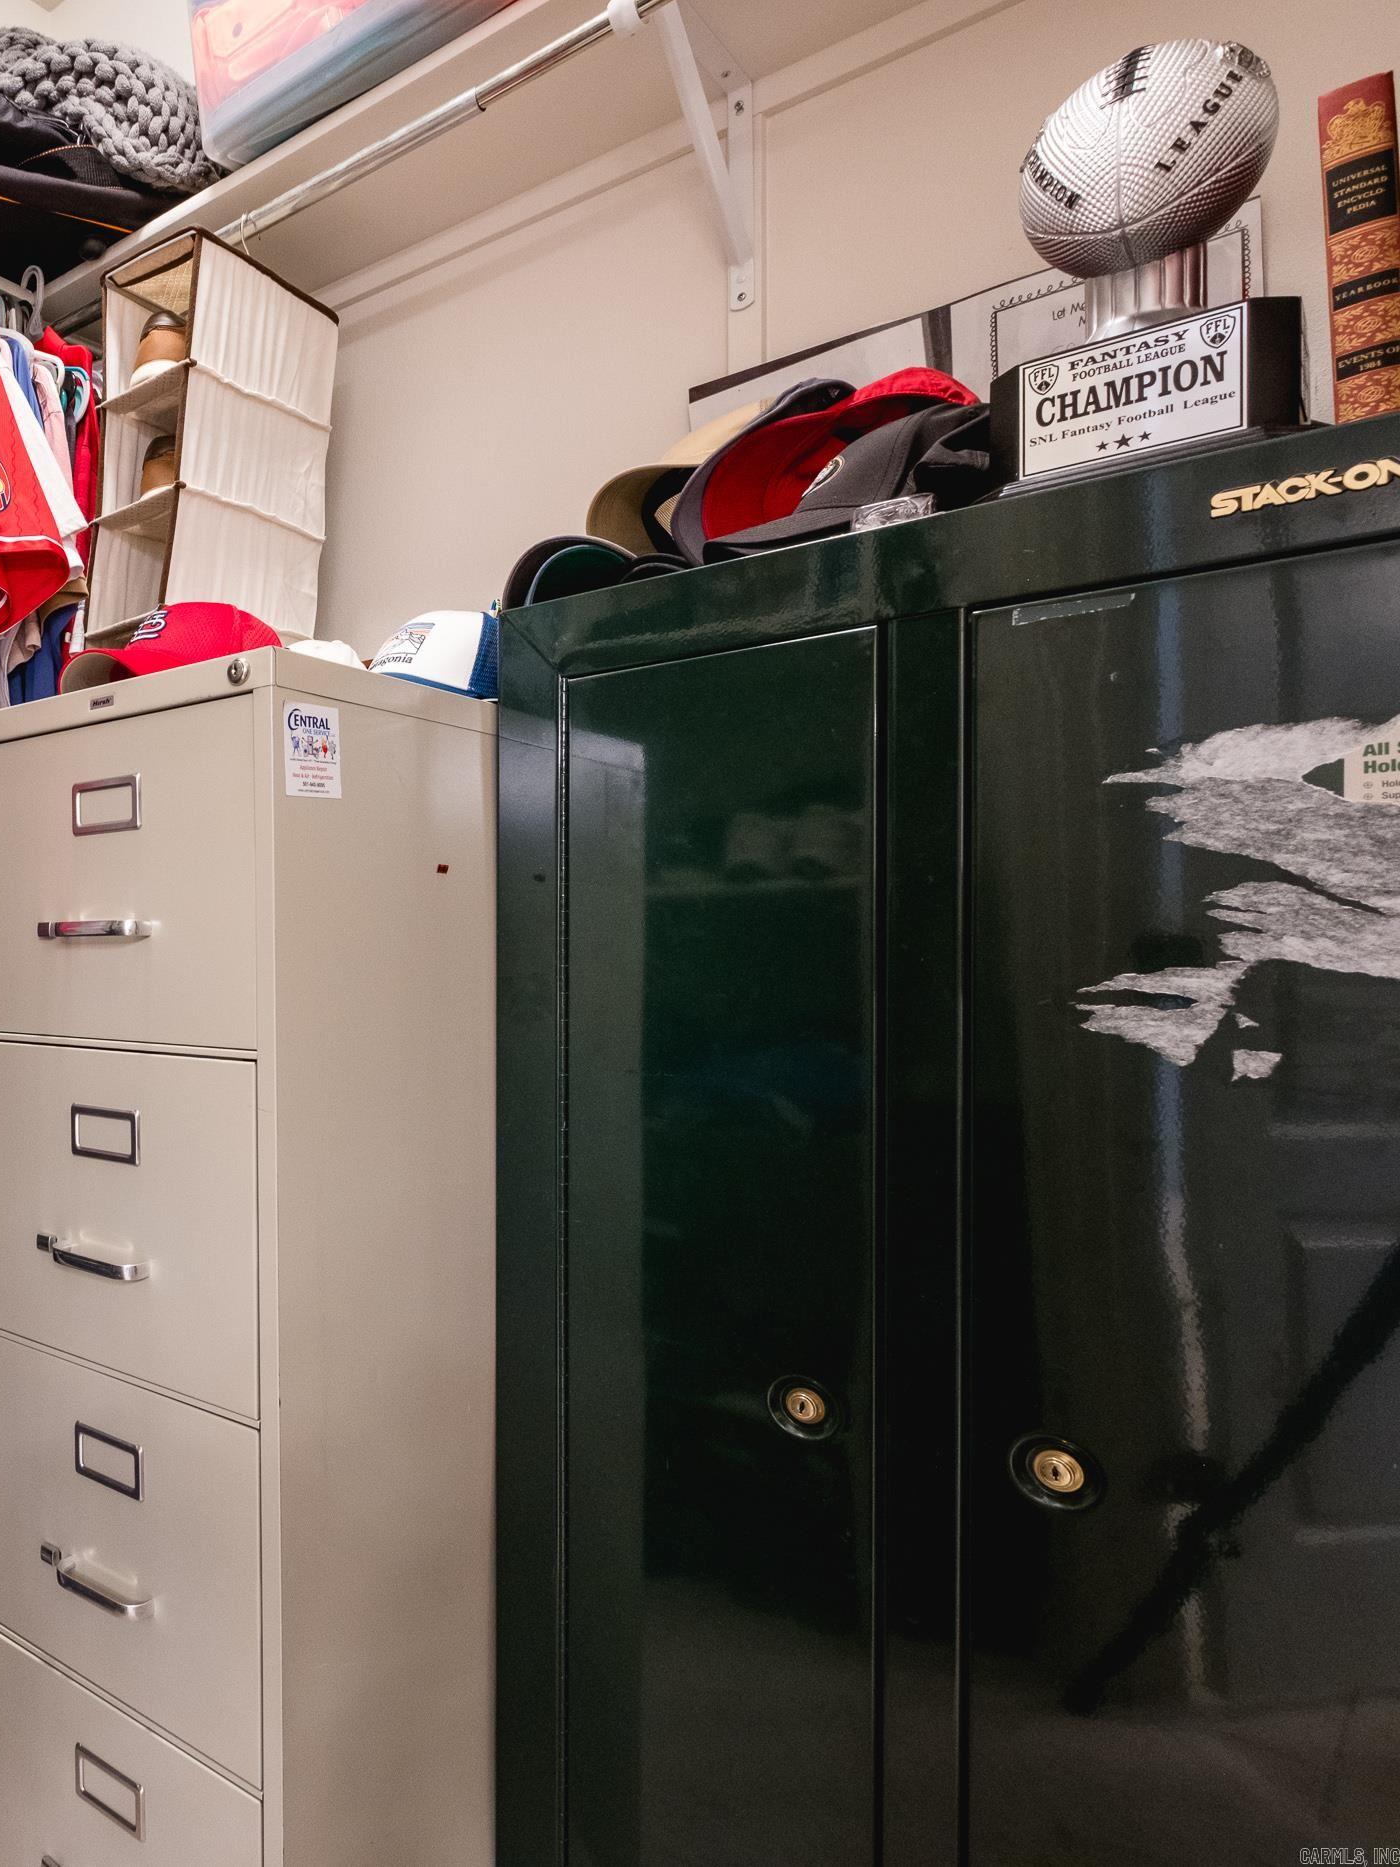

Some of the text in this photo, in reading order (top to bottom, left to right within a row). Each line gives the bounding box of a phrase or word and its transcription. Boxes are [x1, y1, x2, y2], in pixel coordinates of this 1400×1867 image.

[1154, 69, 1244, 173] LEAGUE
[1332, 164, 1388, 187] UNIVERSAL
[1333, 175, 1388, 199] STANDARD
[1337, 187, 1386, 208] ENCYCLO-
[1346, 200, 1377, 214] PEDIA
[1335, 278, 1399, 301] YEARBOOK
[1205, 317, 1230, 335] FFL
[1068, 328, 1191, 372] FANTASY
[1338, 349, 1384, 369] EVENTS
[1072, 343, 1186, 382] FOOTBALL LEAGUE
[1359, 360, 1382, 372] 1984
[1033, 366, 1055, 383] FFL
[1035, 350, 1228, 428] CHAMPION
[1029, 390, 1236, 448] SNL Fantasy Football League
[1210, 457, 1400, 519] STACK-ON
[288, 708, 330, 730] CENTRAL
[1362, 742, 1390, 757] All
[1363, 758, 1400, 774] Hol
